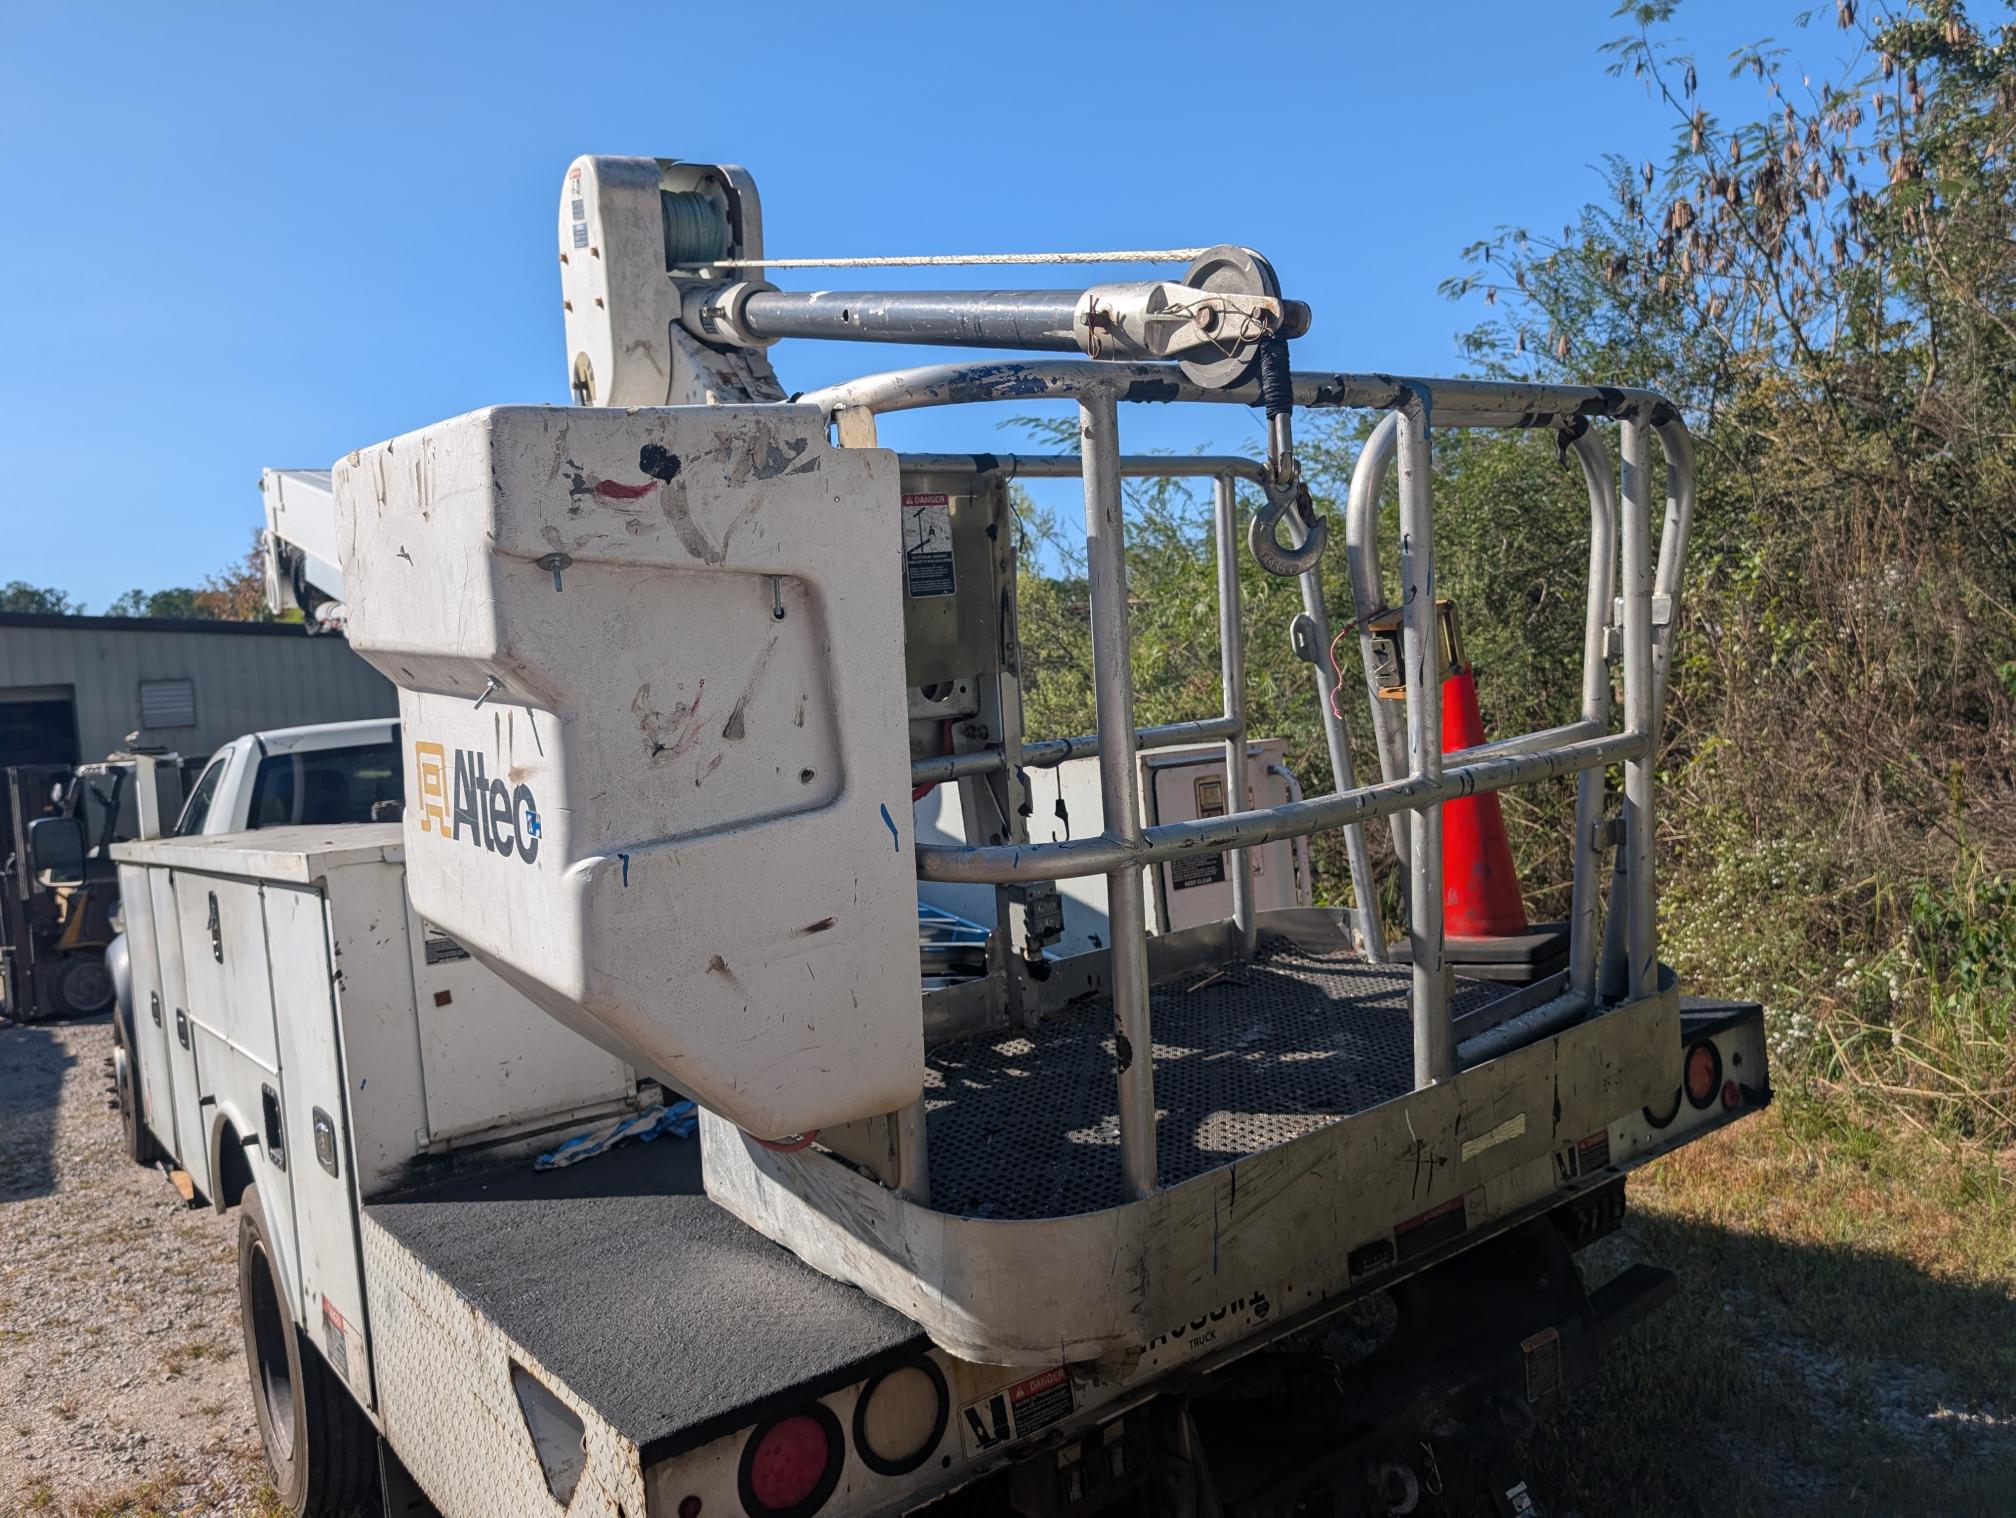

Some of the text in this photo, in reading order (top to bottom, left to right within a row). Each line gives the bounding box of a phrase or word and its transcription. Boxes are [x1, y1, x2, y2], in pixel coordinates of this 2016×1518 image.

[914, 495, 945, 504] DANGER
[453, 749, 538, 864] Altec
[1188, 1329, 1217, 1349] TRUCK
[1030, 1368, 1065, 1391] DANGER
